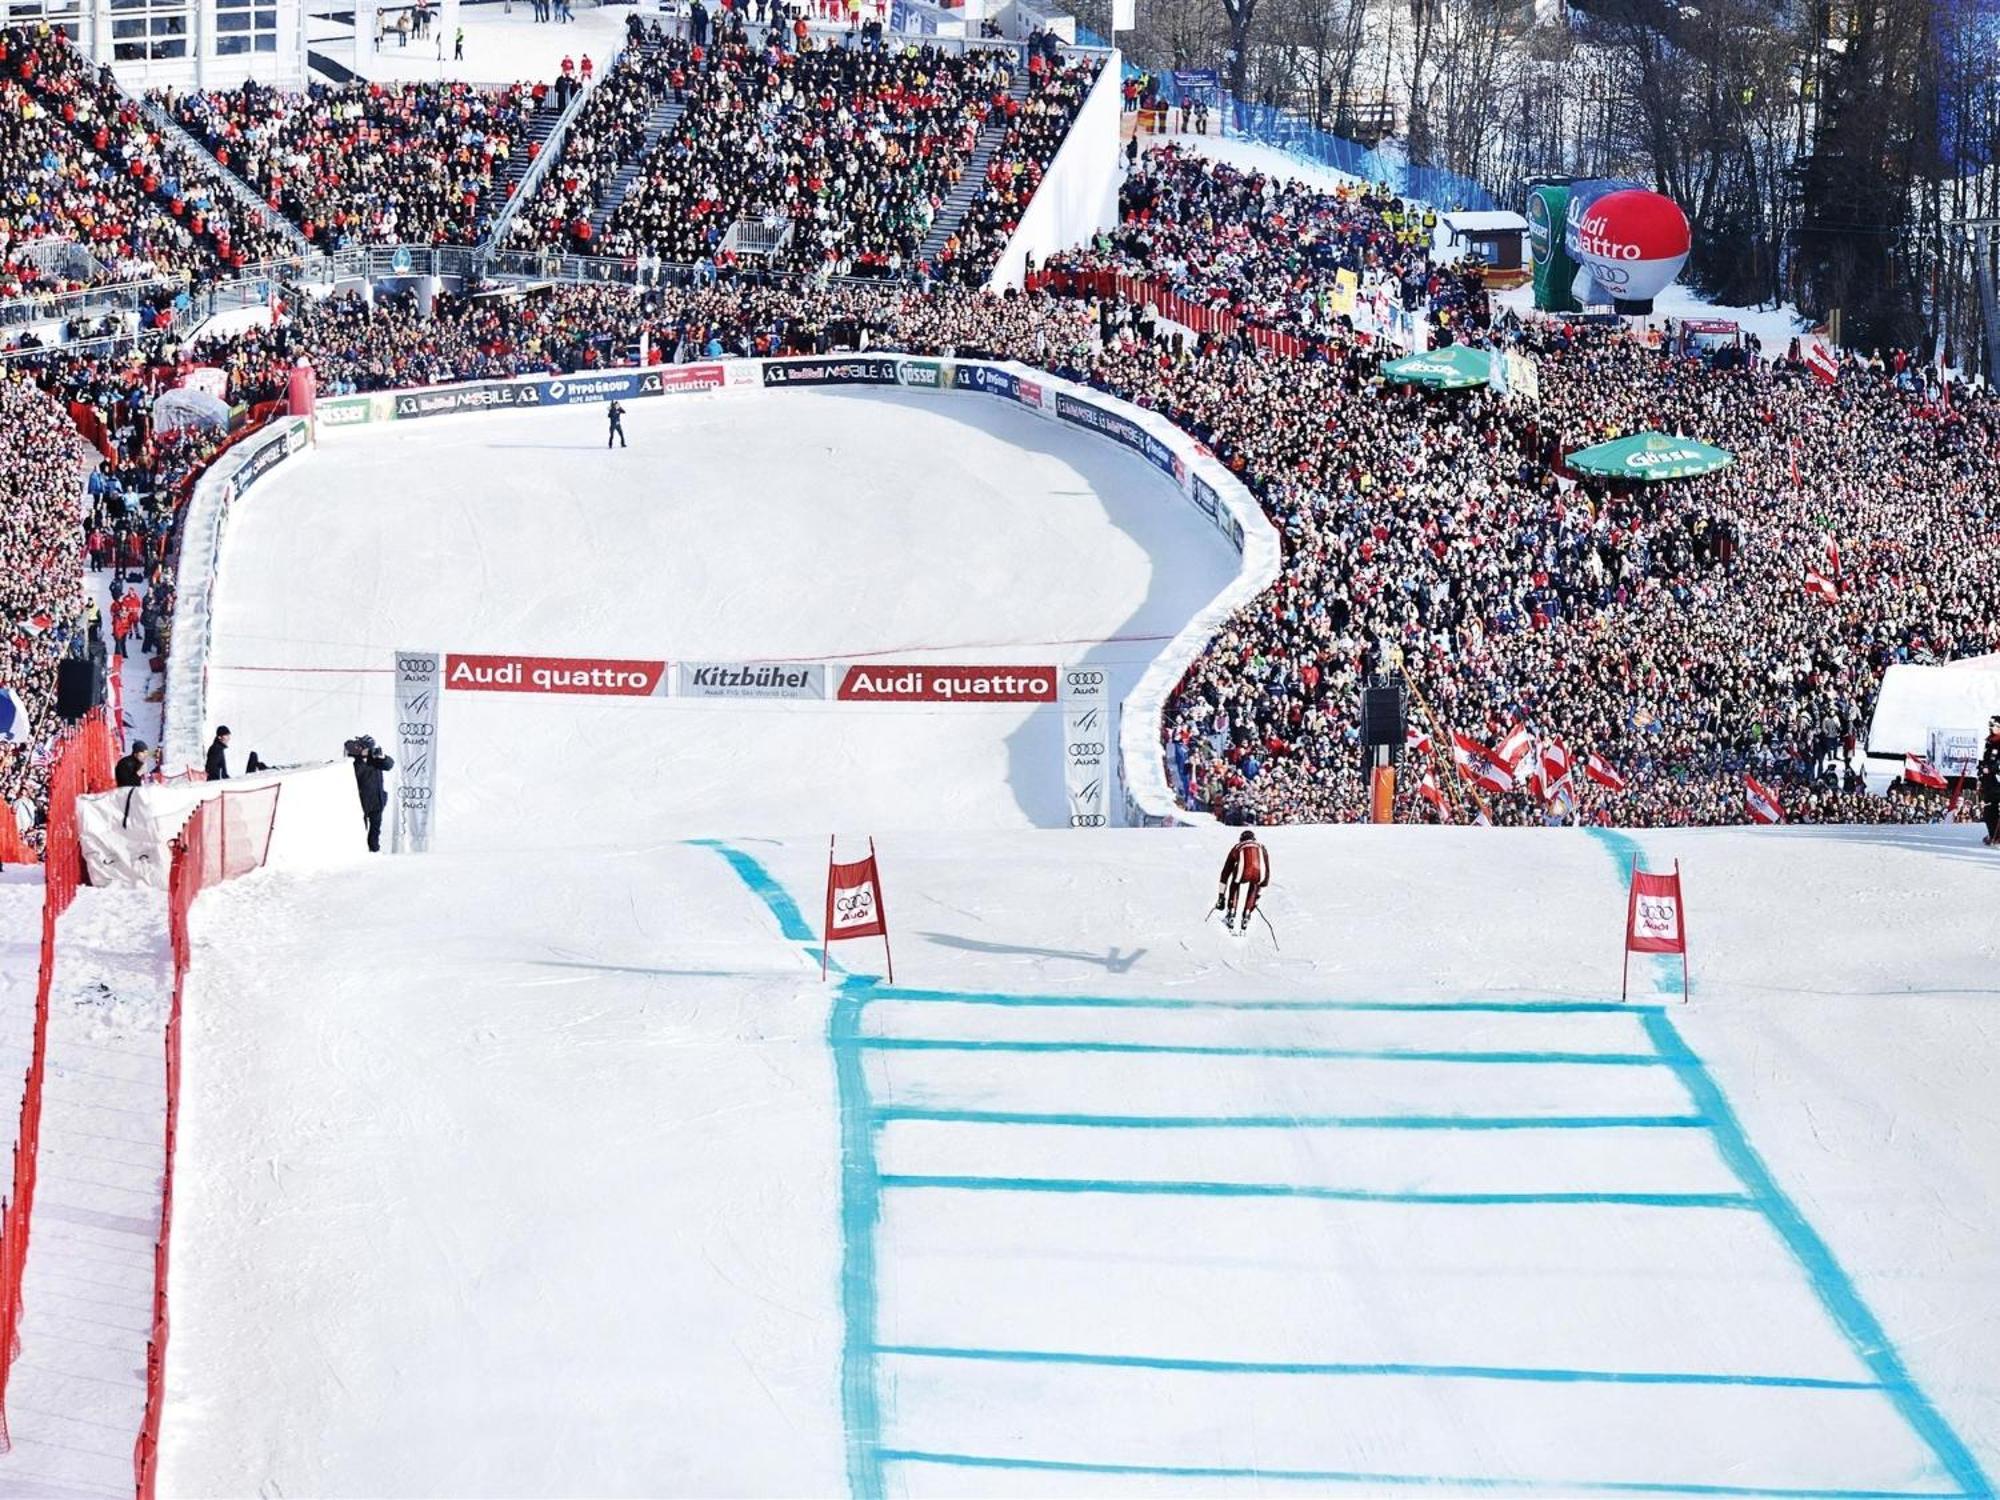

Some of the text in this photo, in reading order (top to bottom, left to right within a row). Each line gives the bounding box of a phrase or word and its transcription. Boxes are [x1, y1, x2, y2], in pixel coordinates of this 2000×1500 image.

[765, 366, 787, 382] A1
[666, 380, 719, 392] quattro
[451, 662, 648, 688] Audi quattro
[693, 666, 808, 688] Kitzbühel
[851, 673, 1049, 698] Audi quattro
[841, 909, 868, 921] Audi
[1643, 919, 1669, 931] Audi
